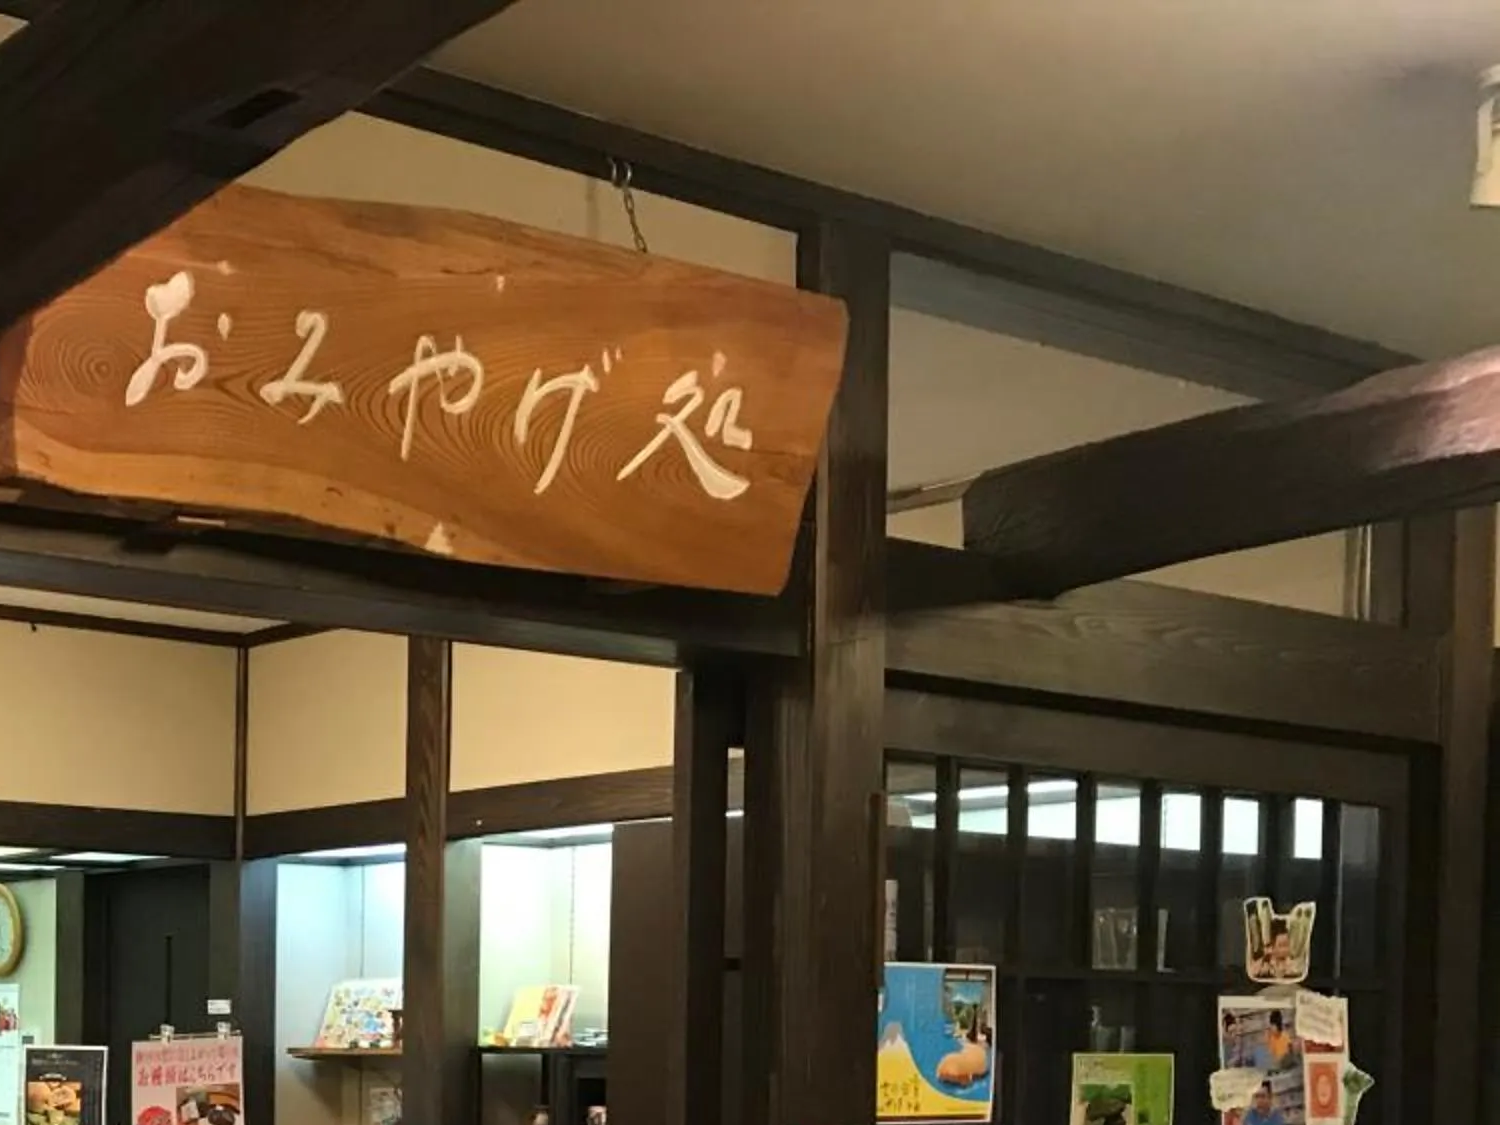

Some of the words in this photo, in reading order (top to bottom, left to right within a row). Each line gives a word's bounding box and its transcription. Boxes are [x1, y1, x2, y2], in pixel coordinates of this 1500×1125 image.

[124, 271, 753, 500] おみやげ処
